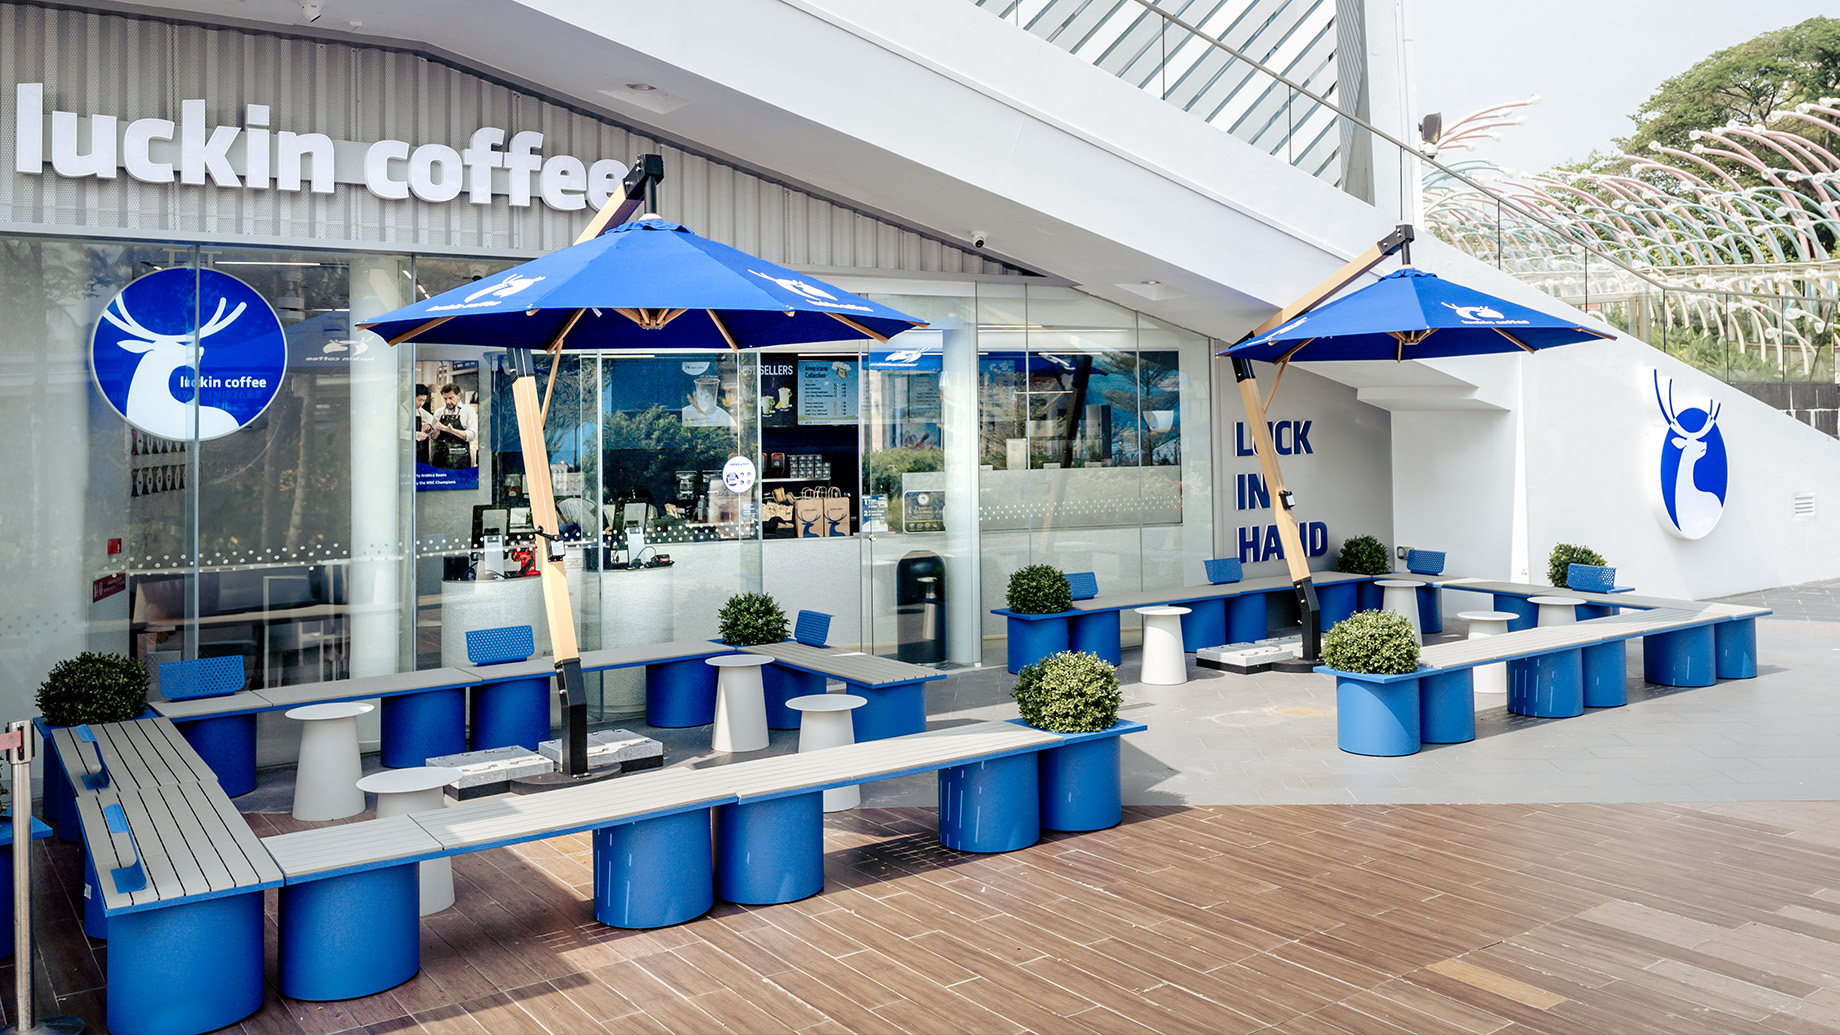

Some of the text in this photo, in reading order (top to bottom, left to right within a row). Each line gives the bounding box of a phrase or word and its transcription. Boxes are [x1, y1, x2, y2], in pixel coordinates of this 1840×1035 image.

[16, 83, 629, 212] luckin coffee
[224, 376, 267, 388] coffee
[760, 364, 794, 376] SELLERS
[1234, 420, 1314, 457] LCK
[1235, 473, 1271, 511] IN
